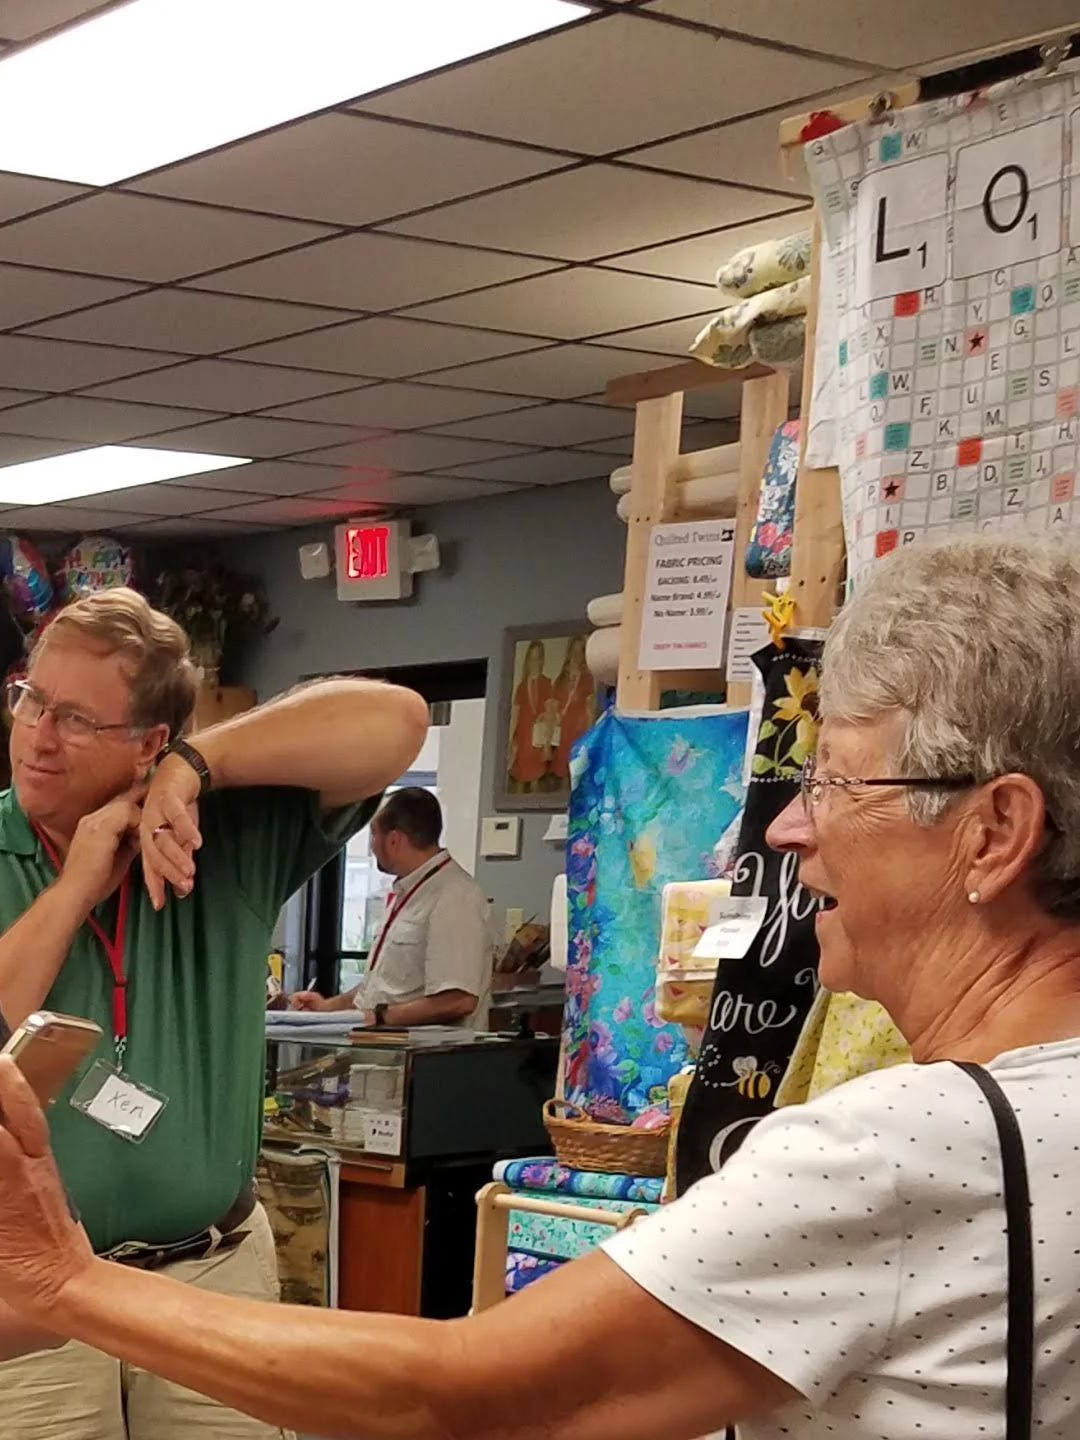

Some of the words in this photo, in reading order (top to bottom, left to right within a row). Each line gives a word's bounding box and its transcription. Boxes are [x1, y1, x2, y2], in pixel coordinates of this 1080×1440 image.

[973, 303, 982, 319] Y
[945, 337, 956, 351] N
[893, 375, 908, 390] W
[1040, 371, 1050, 386] S
[921, 397, 930, 413] F
[986, 410, 1000, 426] M
[940, 420, 951, 435] K
[710, 990, 798, 1035] are
